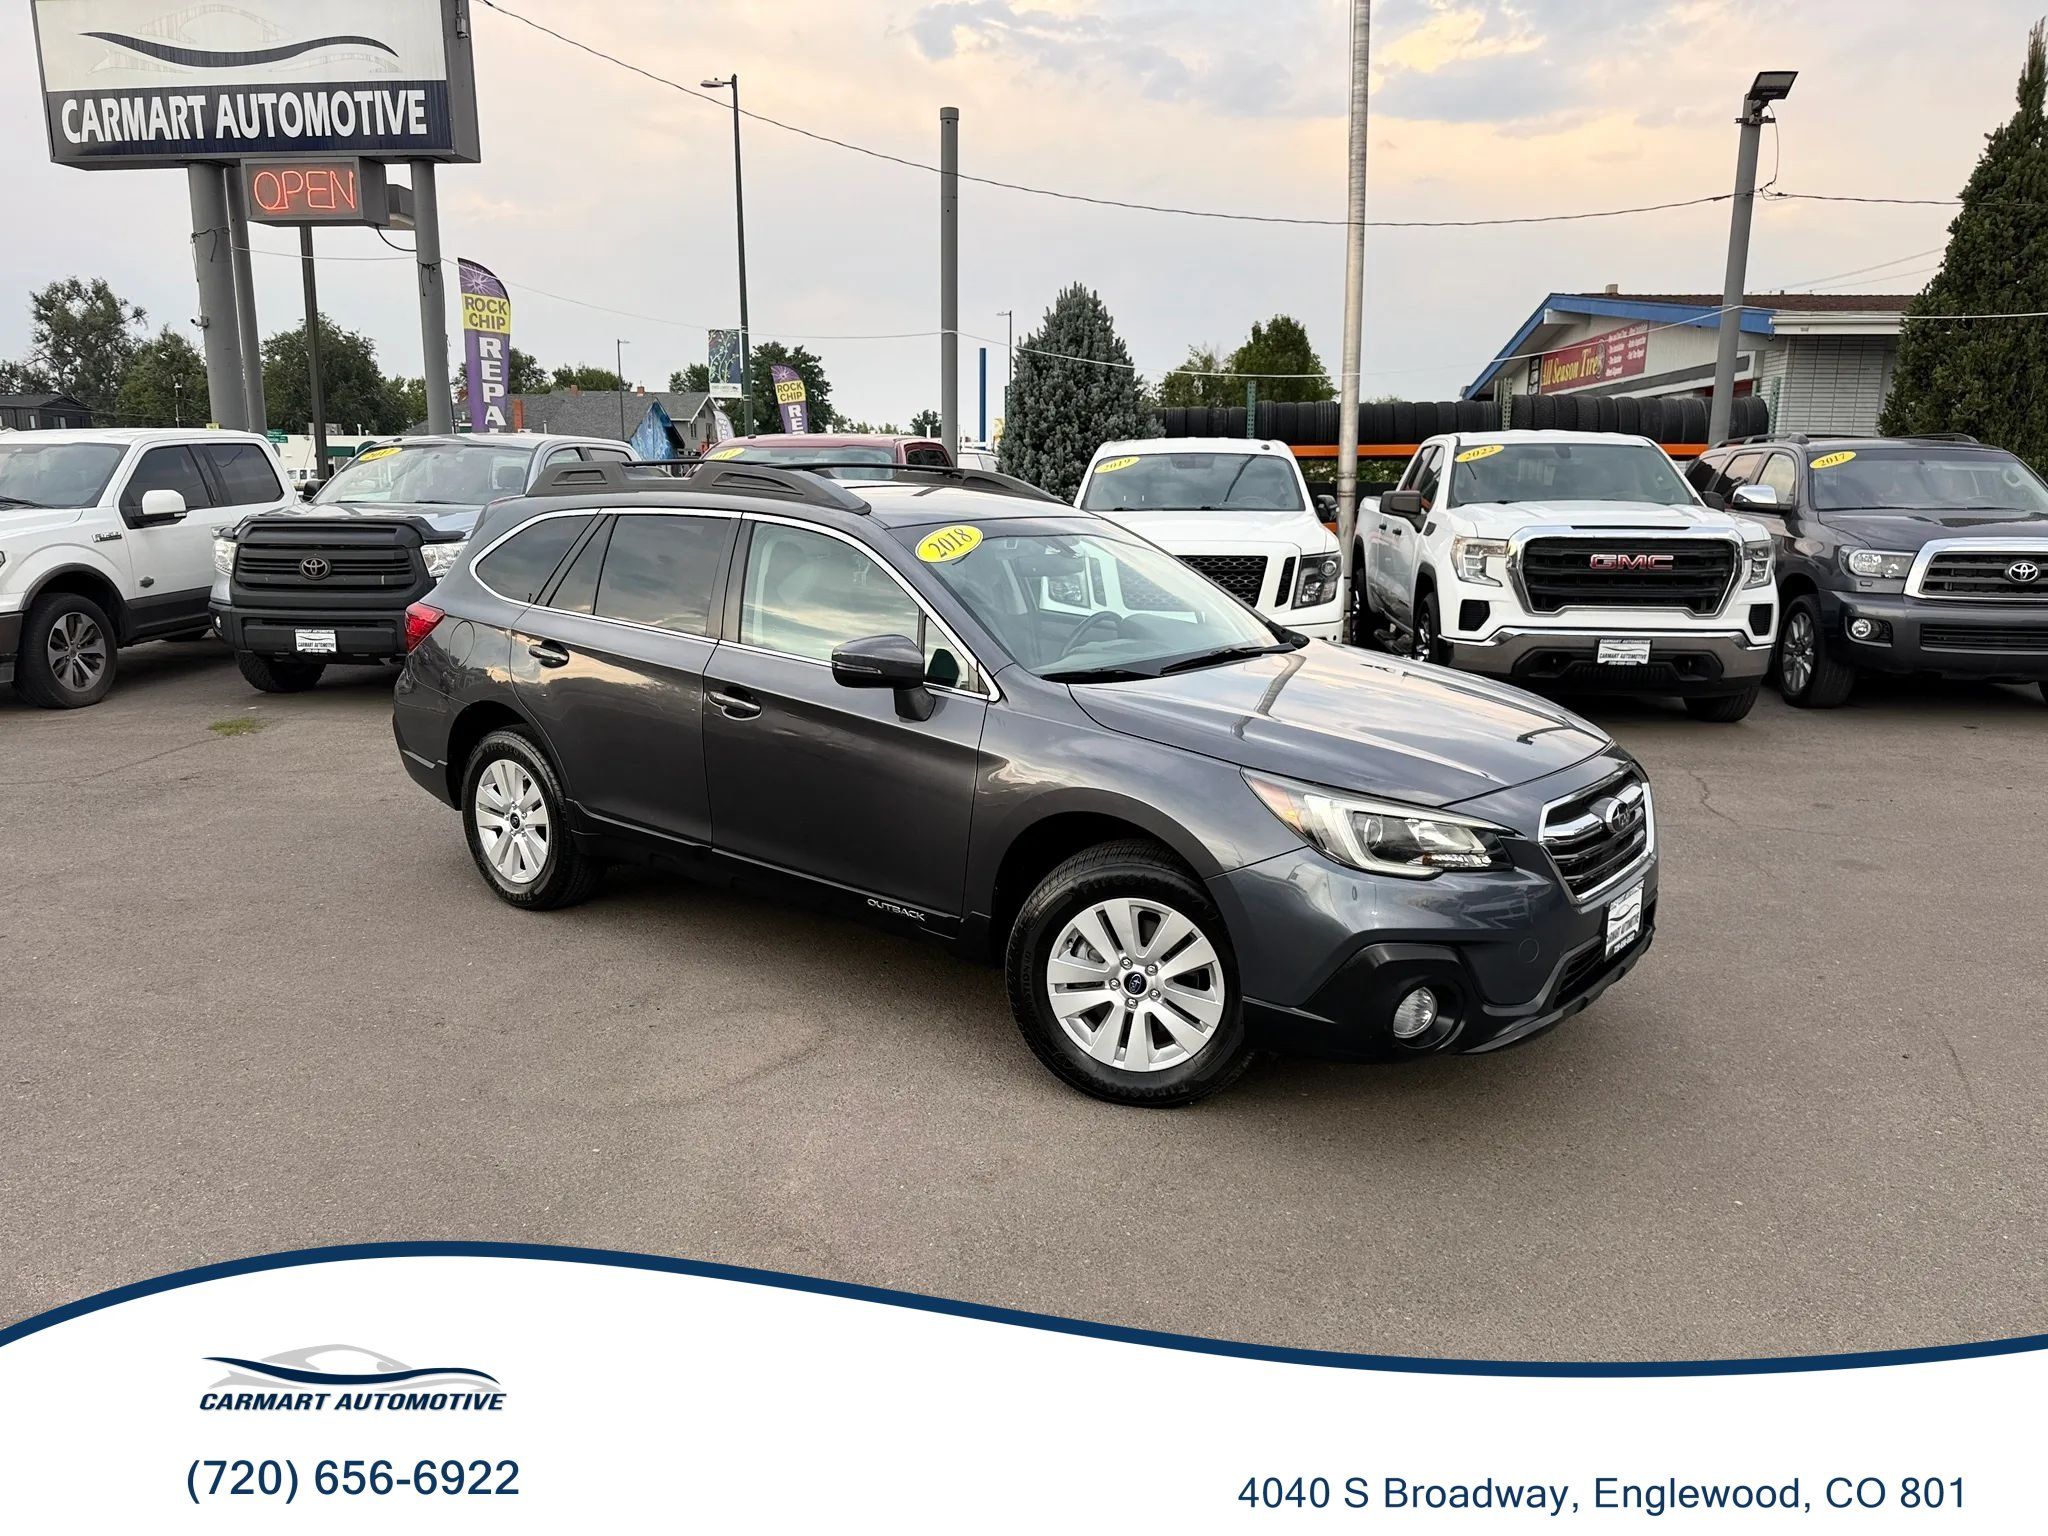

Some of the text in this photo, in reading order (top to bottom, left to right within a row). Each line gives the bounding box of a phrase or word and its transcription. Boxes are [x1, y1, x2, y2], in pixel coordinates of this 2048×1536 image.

[61, 89, 427, 144] CARMART AUTOMOTIVE
[254, 170, 355, 211] OPEN
[464, 295, 508, 316] ROCK
[469, 312, 506, 331] CHIP
[1552, 358, 1579, 383] Season
[479, 336, 507, 433] REPA
[777, 382, 803, 393] ROCK
[780, 391, 803, 402] CHIP
[788, 404, 805, 435] RE
[1819, 453, 1845, 466] 2017
[928, 528, 973, 558] 2018
[1590, 554, 1674, 569] GMC
[867, 898, 926, 922] OUTBACK
